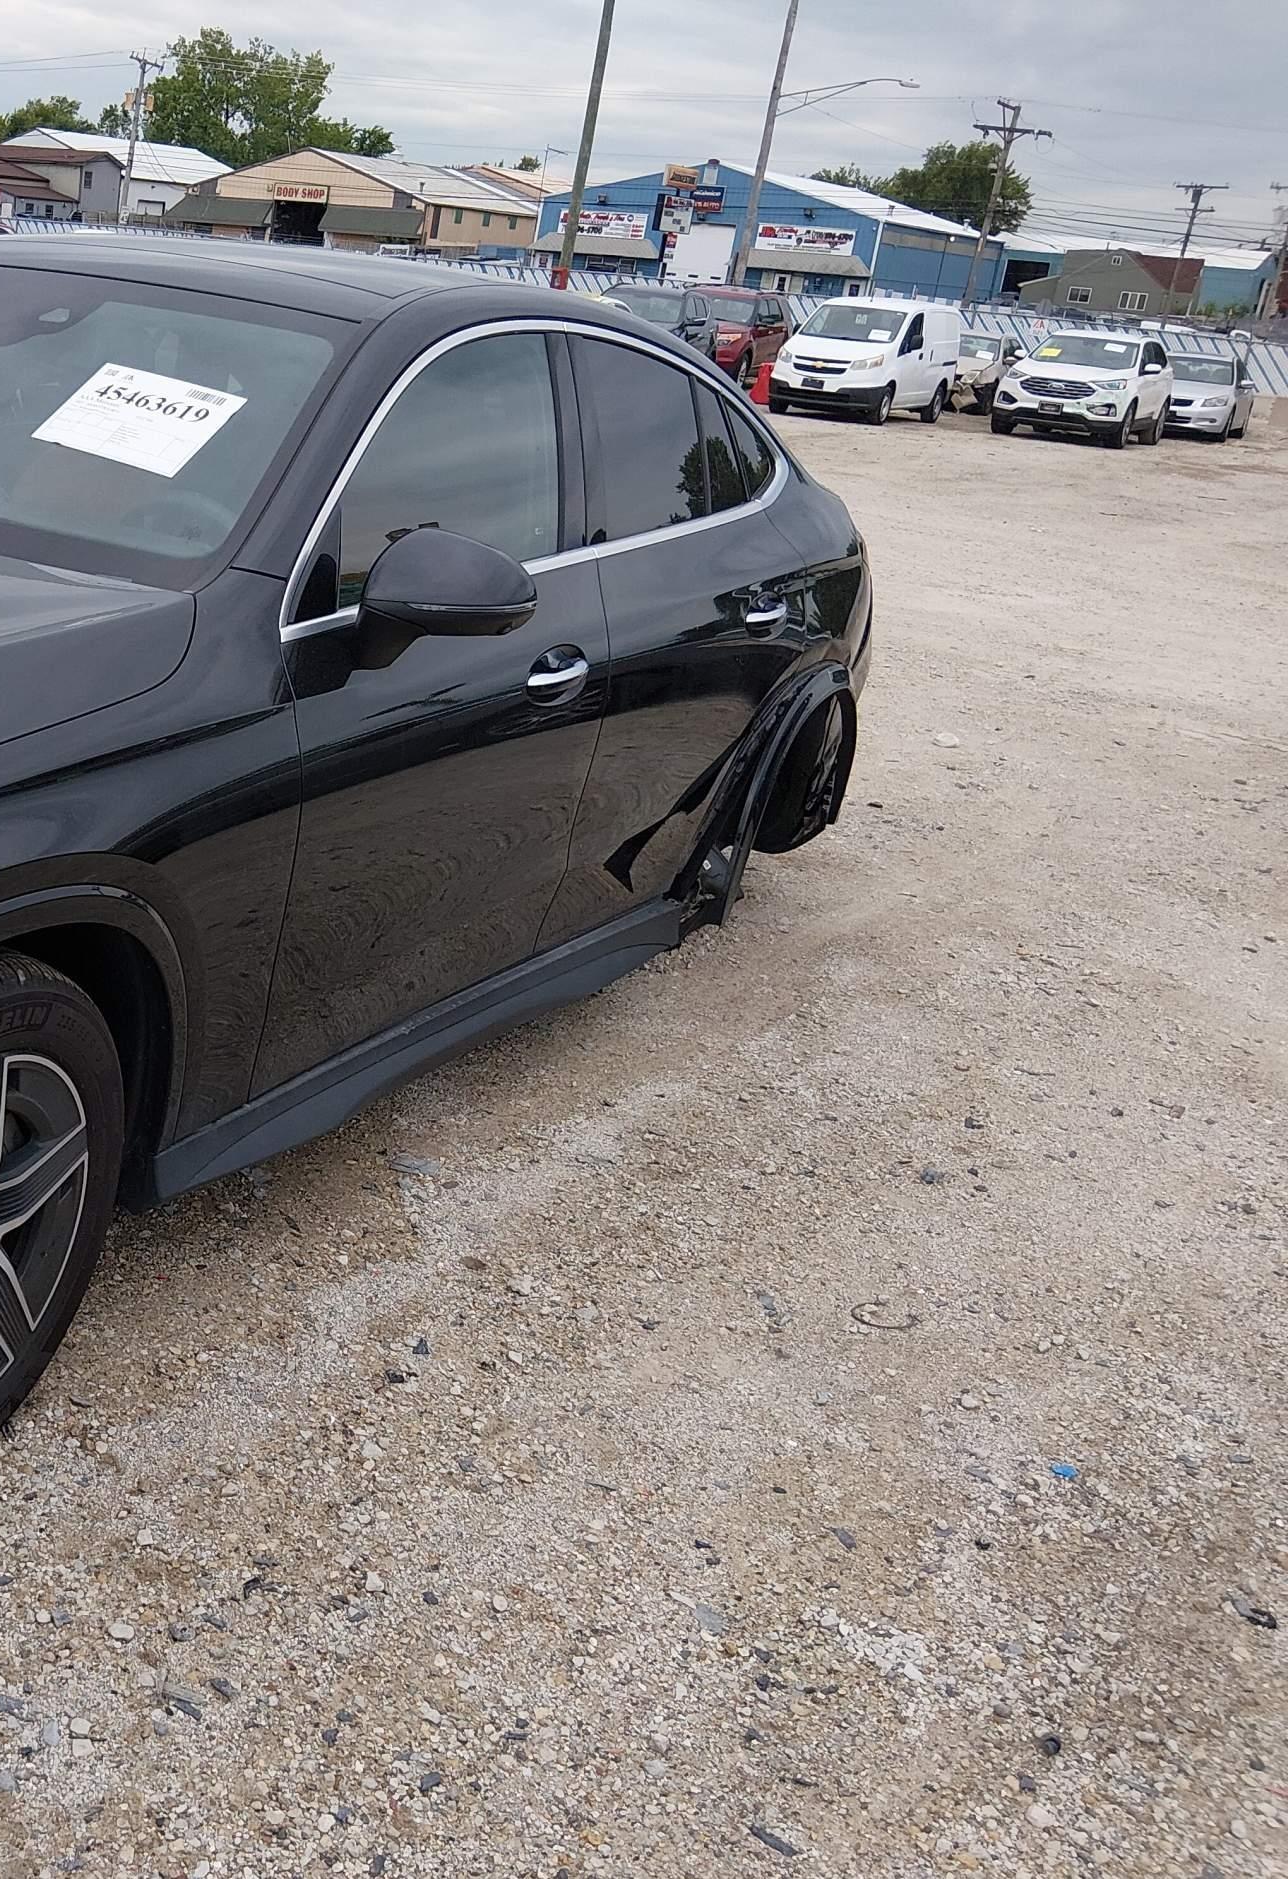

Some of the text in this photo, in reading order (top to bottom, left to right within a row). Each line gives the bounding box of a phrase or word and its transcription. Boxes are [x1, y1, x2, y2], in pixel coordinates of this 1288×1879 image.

[276, 186, 325, 199] BODY SHOP
[95, 384, 210, 423] 45463619
